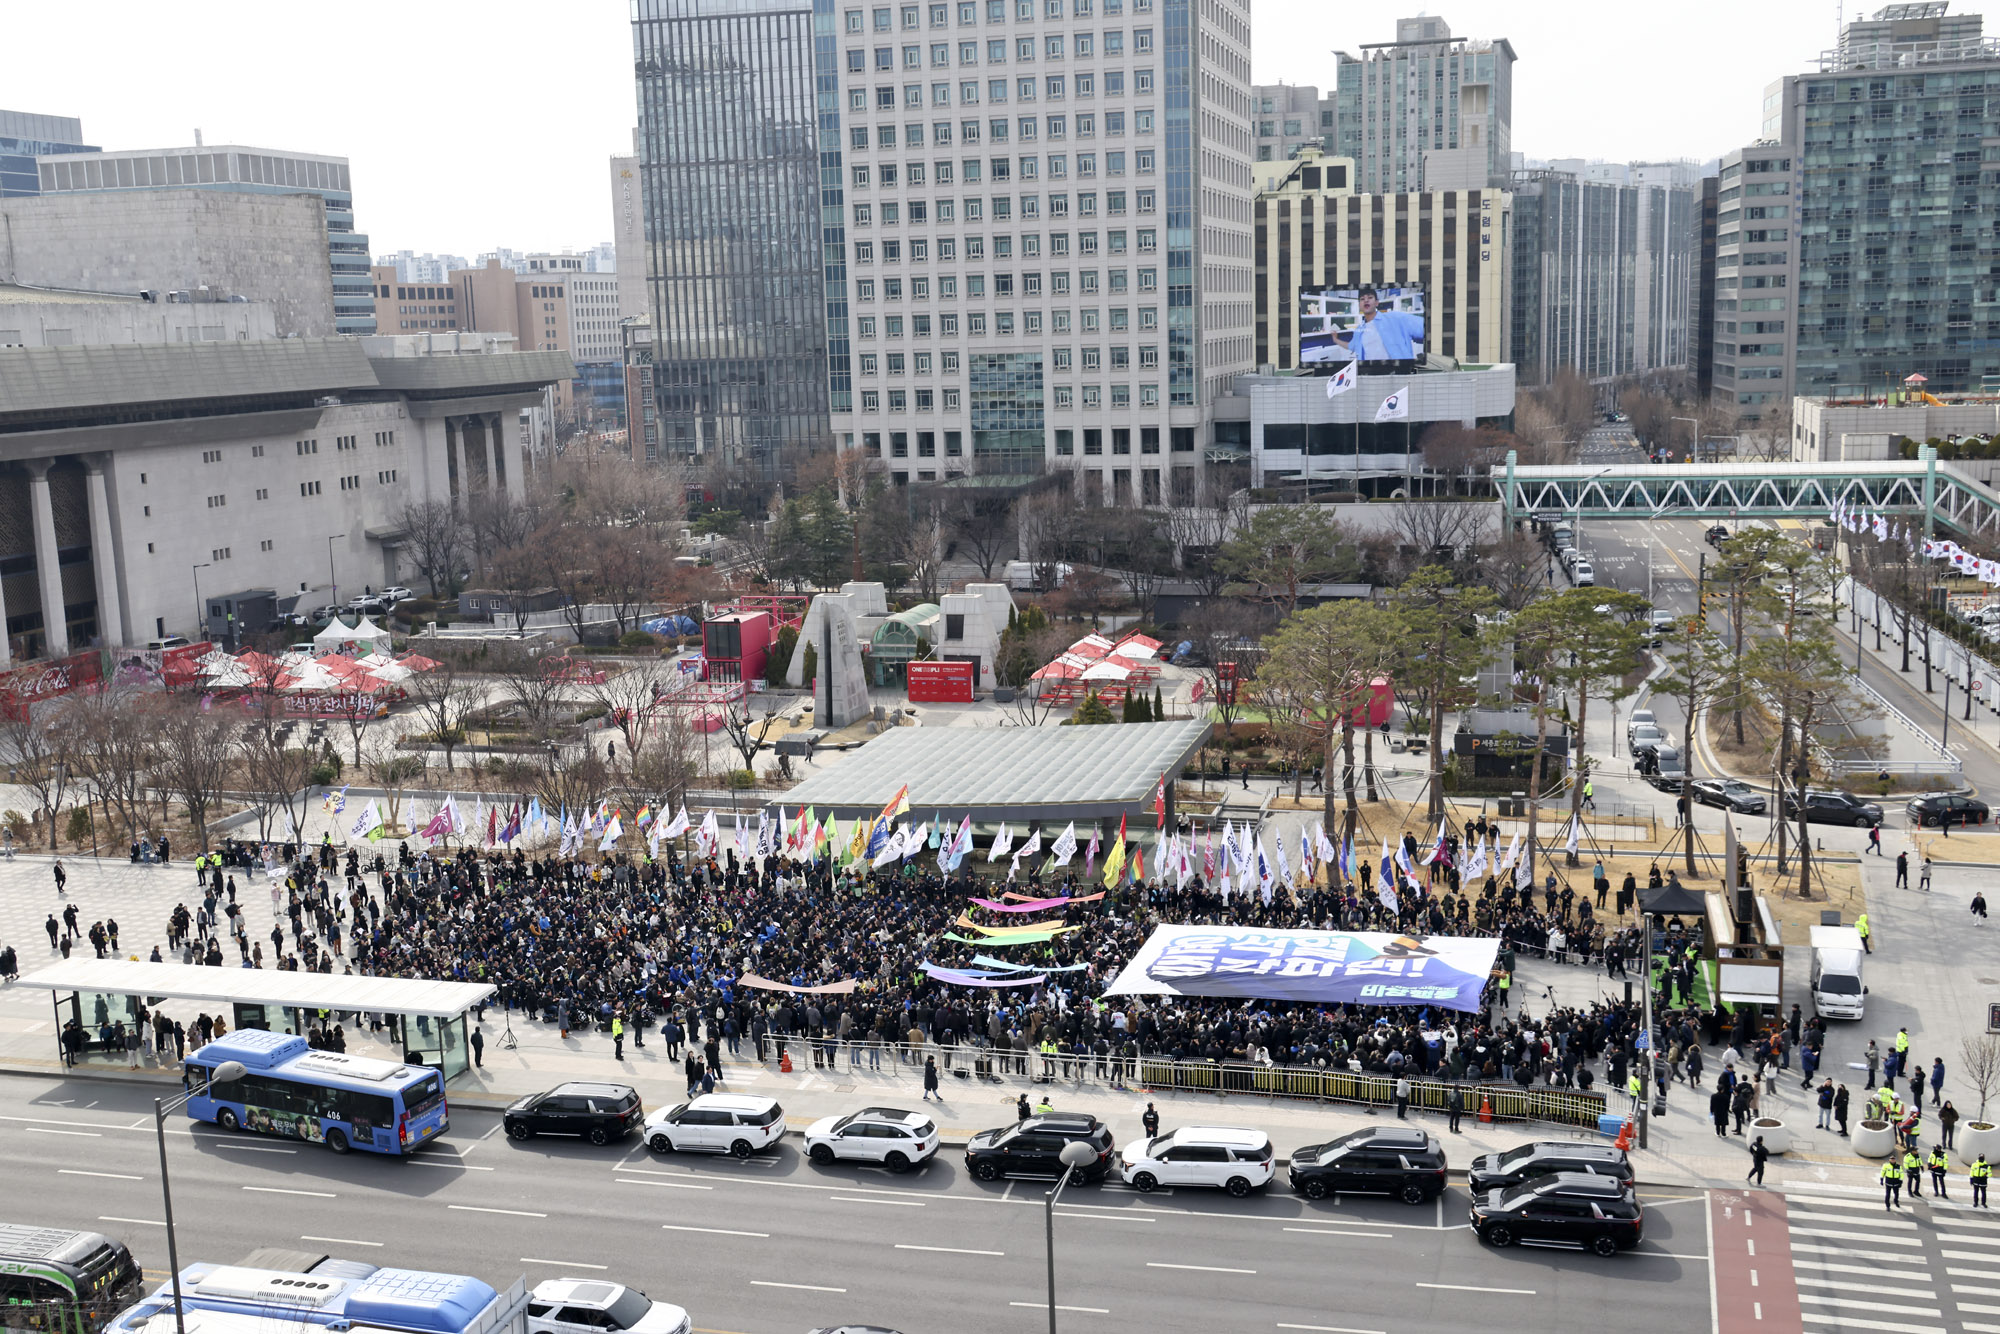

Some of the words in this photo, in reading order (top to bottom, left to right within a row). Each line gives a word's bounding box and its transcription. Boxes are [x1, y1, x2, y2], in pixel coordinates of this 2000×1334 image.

[1481, 199, 1491, 262] 도렴빌딩
[283, 696, 306, 711] 한식
[1166, 936, 1352, 962] 윤석열
[326, 1110, 341, 1121] 406
